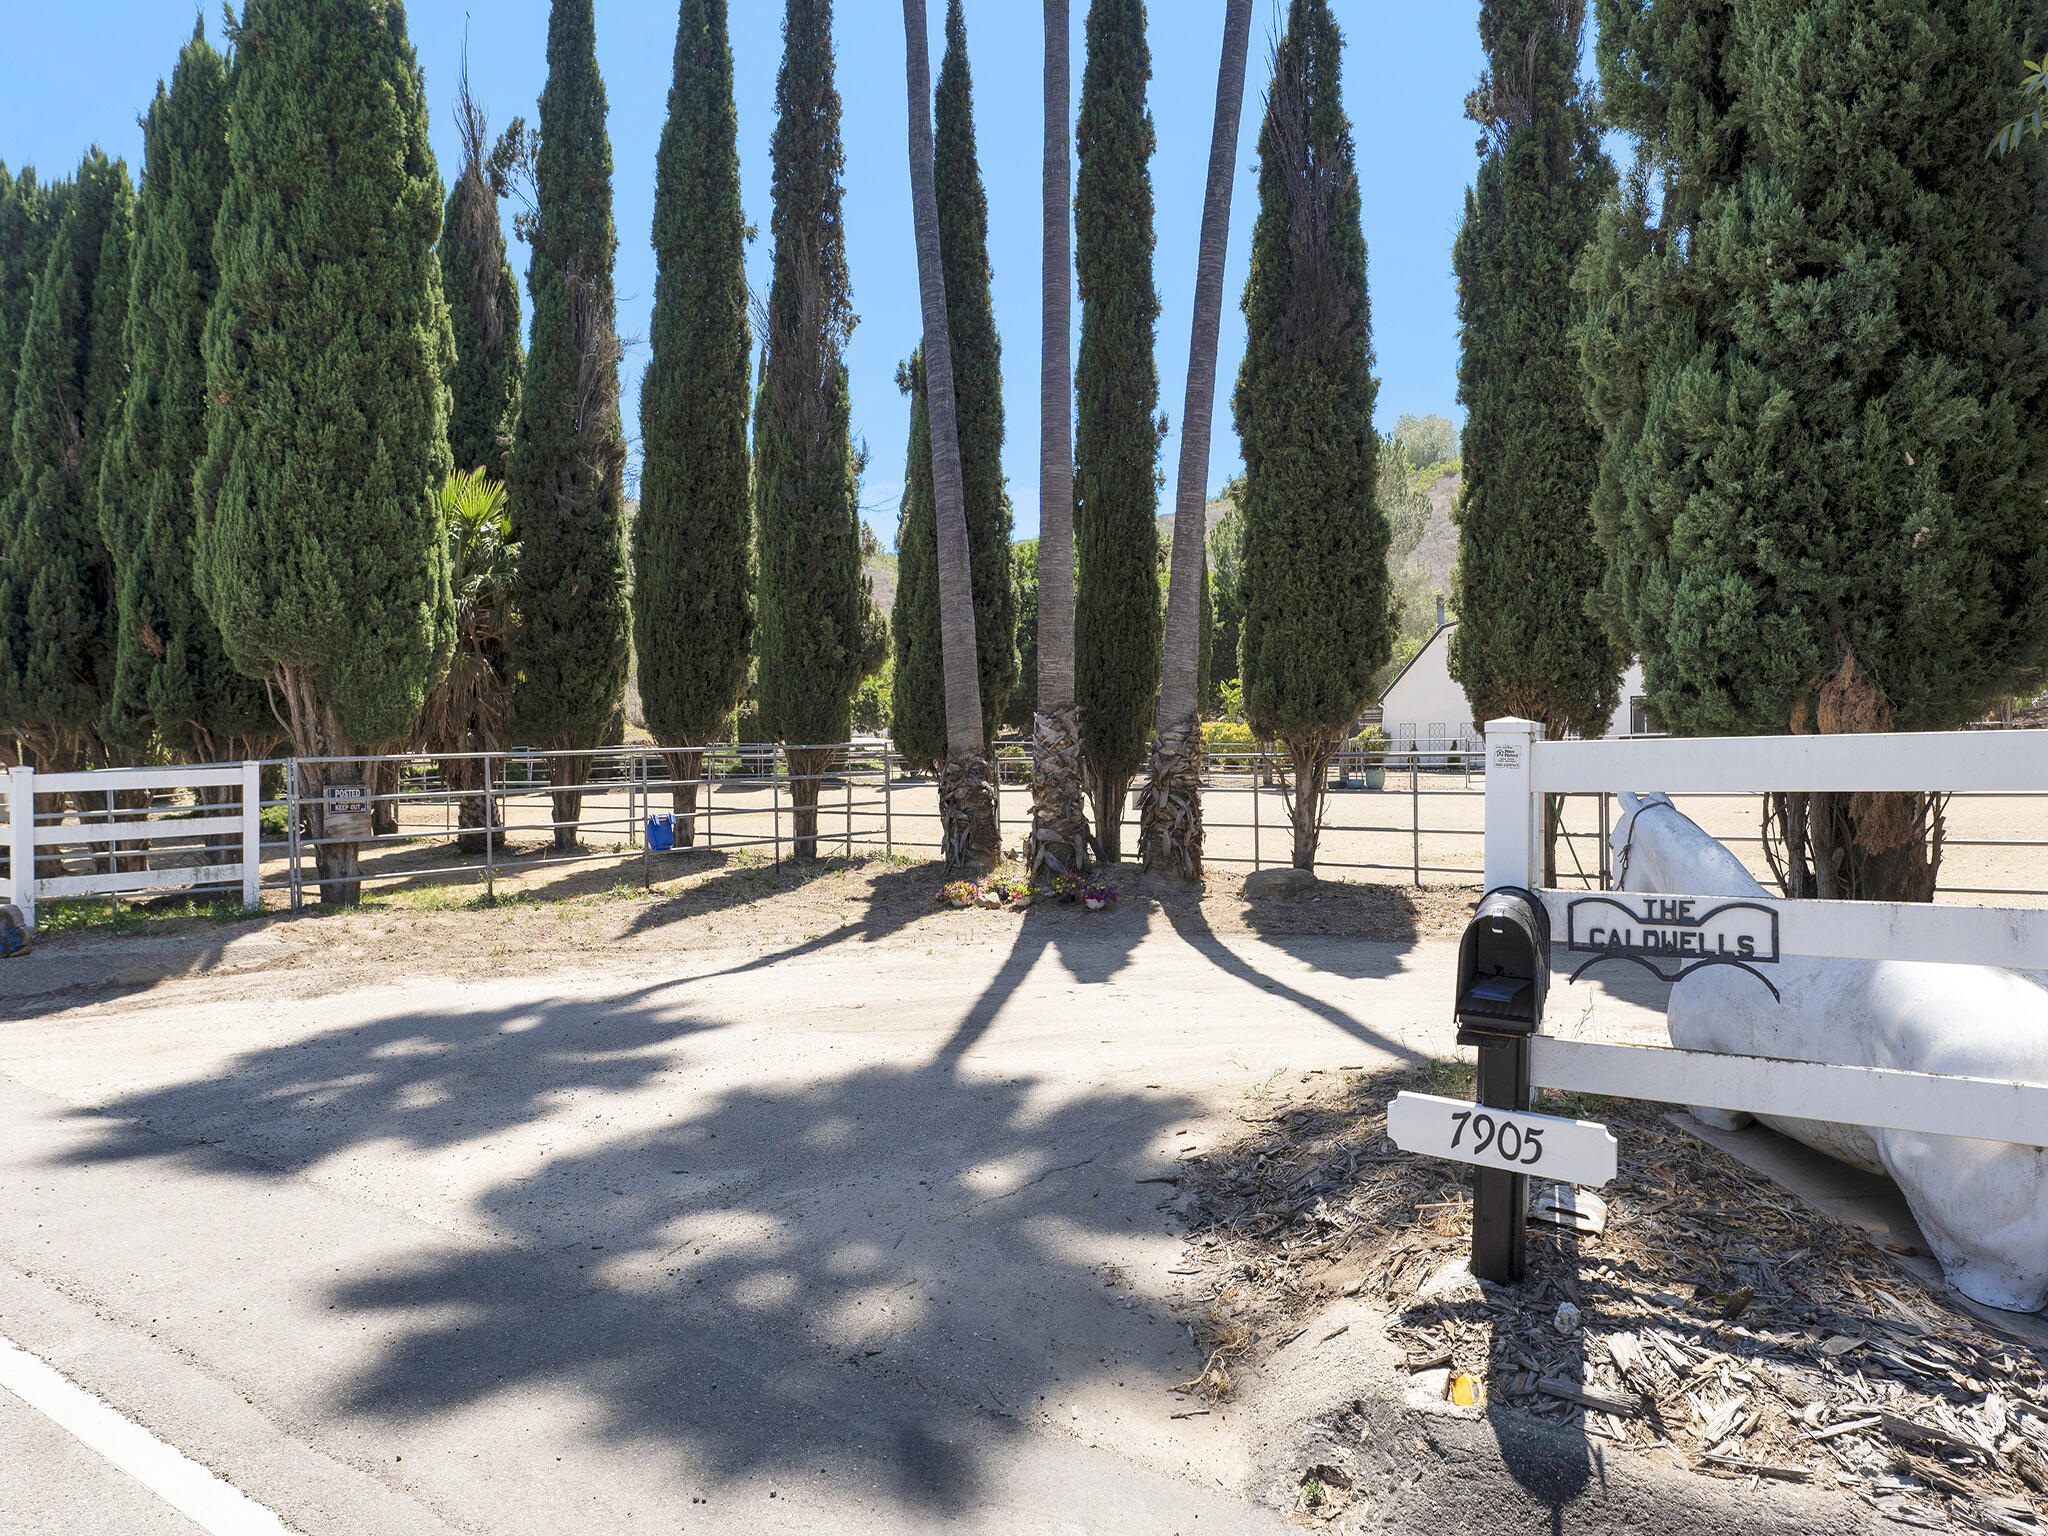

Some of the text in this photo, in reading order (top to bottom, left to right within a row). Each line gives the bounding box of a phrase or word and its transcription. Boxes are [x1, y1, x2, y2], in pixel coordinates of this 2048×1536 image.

[335, 789, 361, 798] POSTED
[1642, 899, 1696, 921] THE
[1589, 927, 1755, 957] CALDWELLS
[1450, 1111, 1544, 1165] 7905
